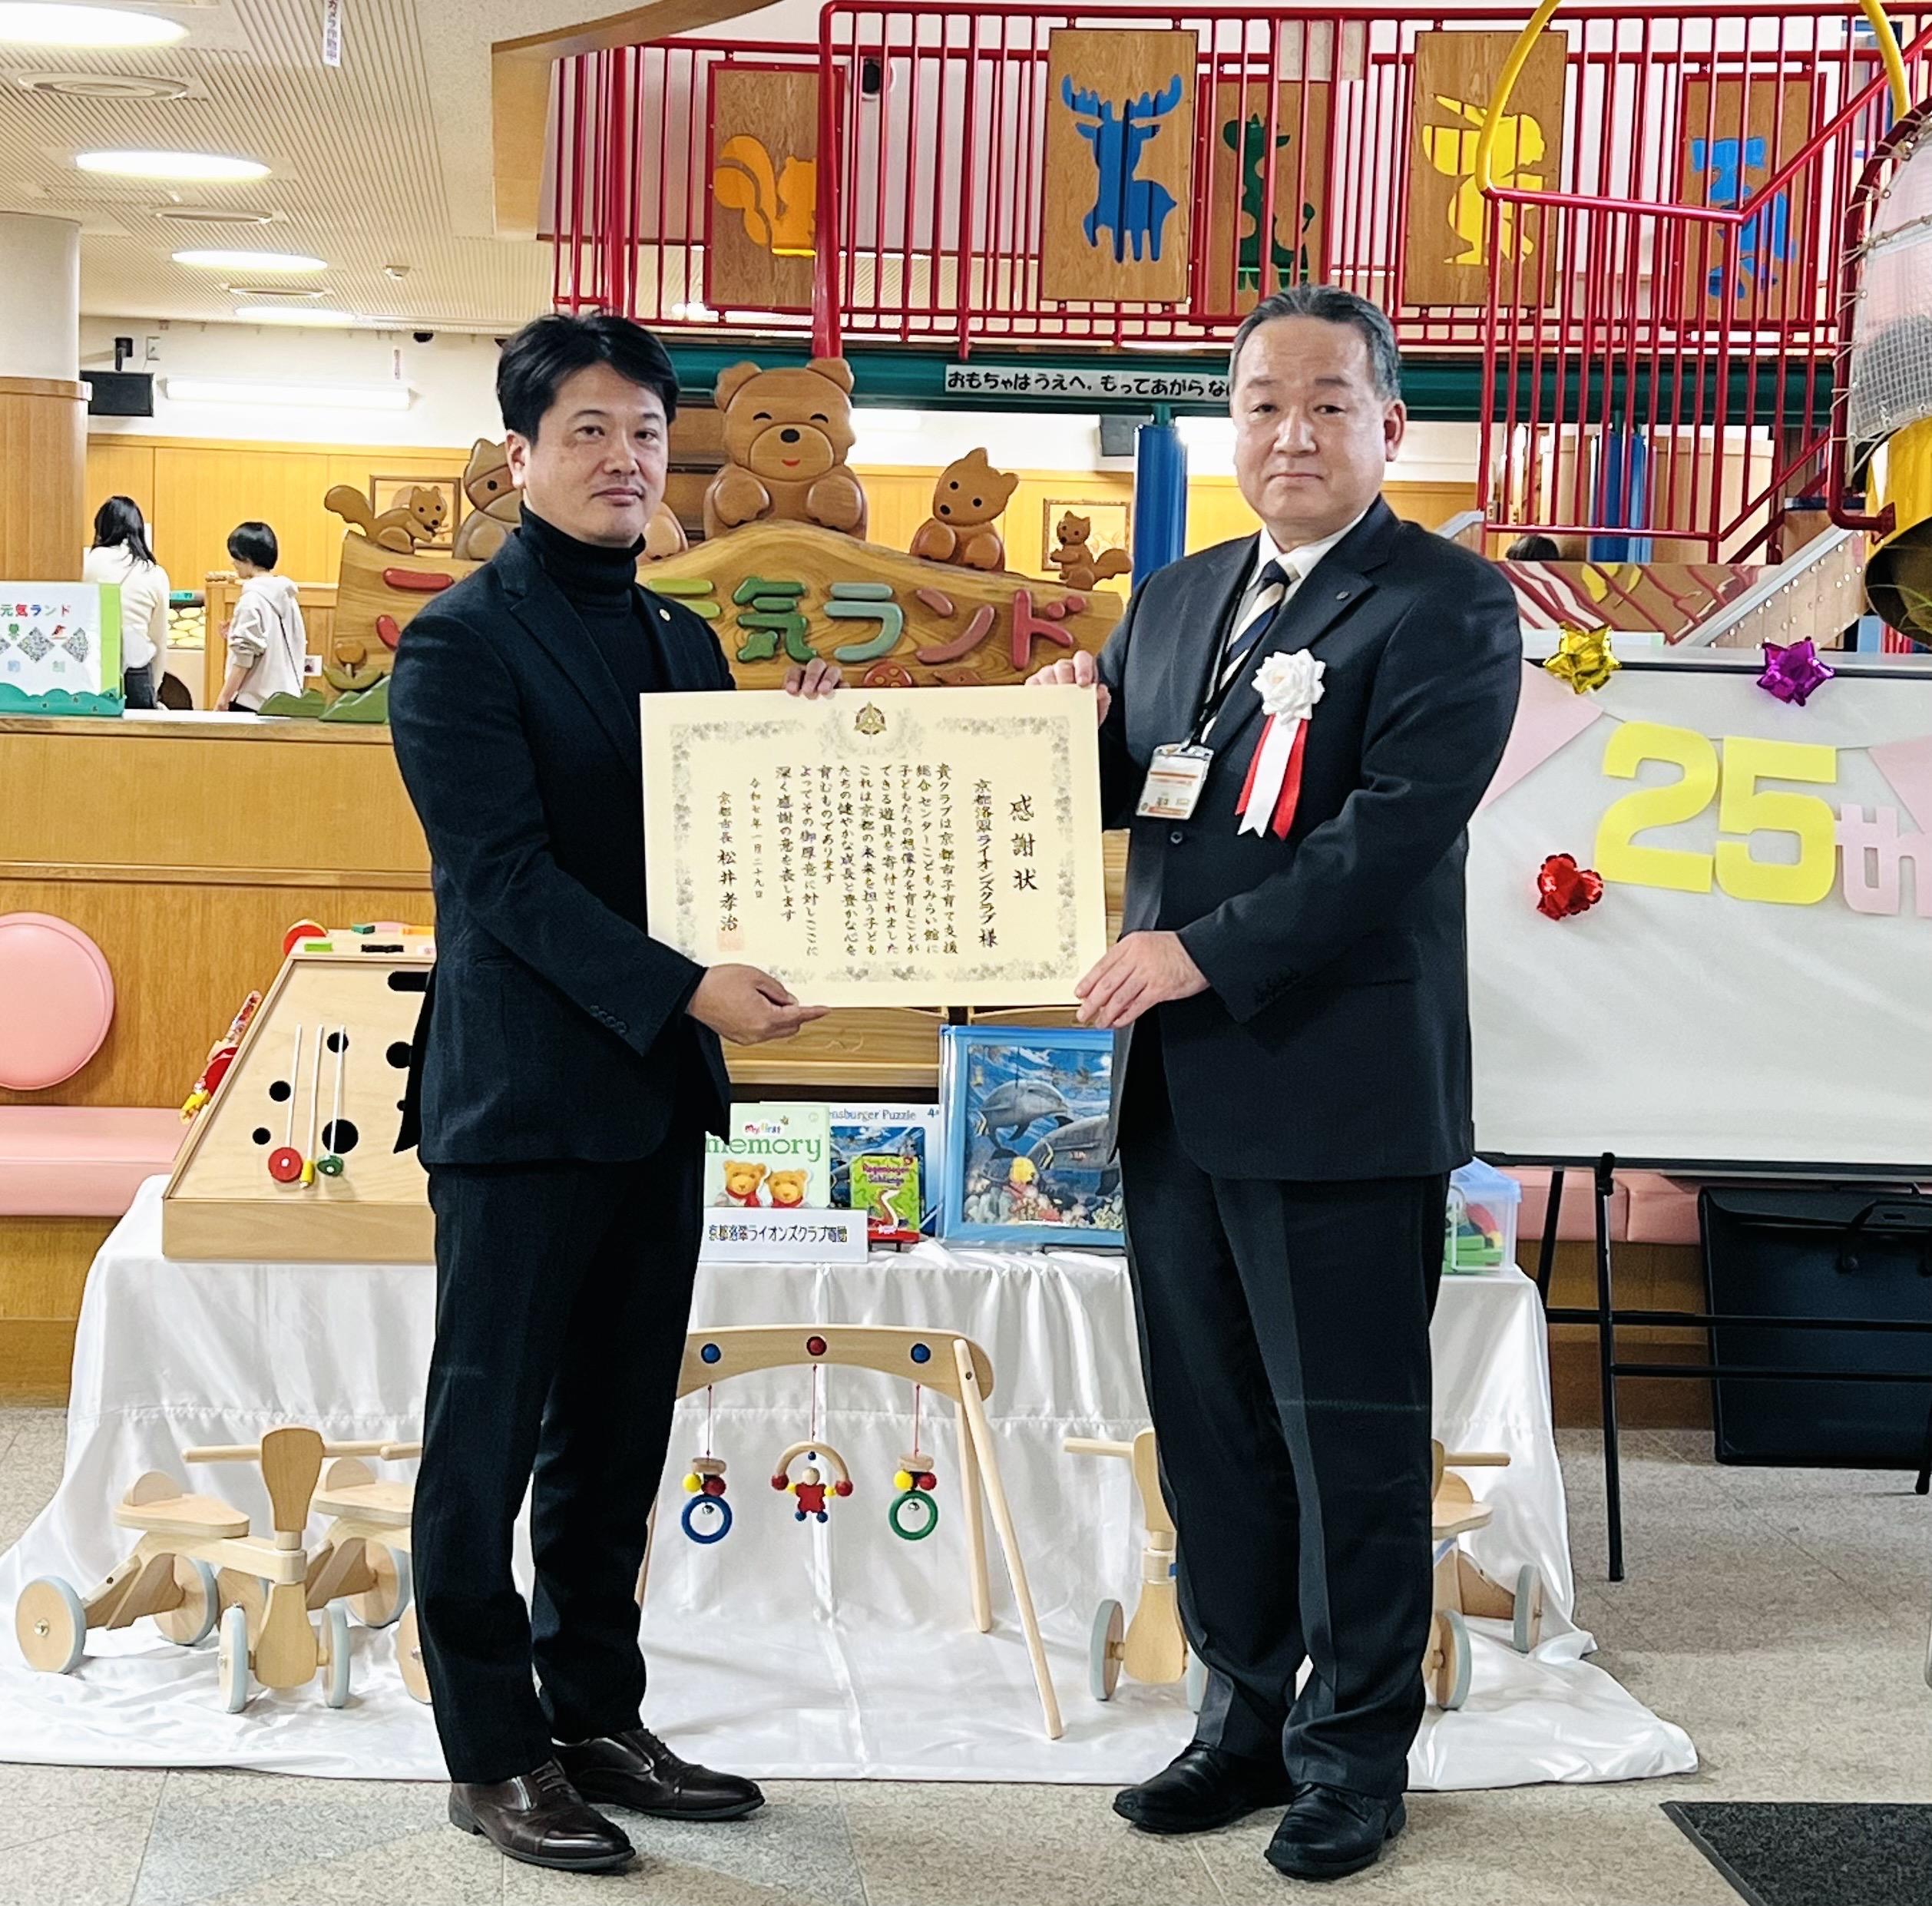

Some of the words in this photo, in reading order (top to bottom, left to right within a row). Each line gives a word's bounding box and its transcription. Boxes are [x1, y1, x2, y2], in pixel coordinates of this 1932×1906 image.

[0, 604, 71, 617] 元気ランド
[1009, 793, 1039, 892] 感謝状
[706, 1137, 822, 1163] memory
